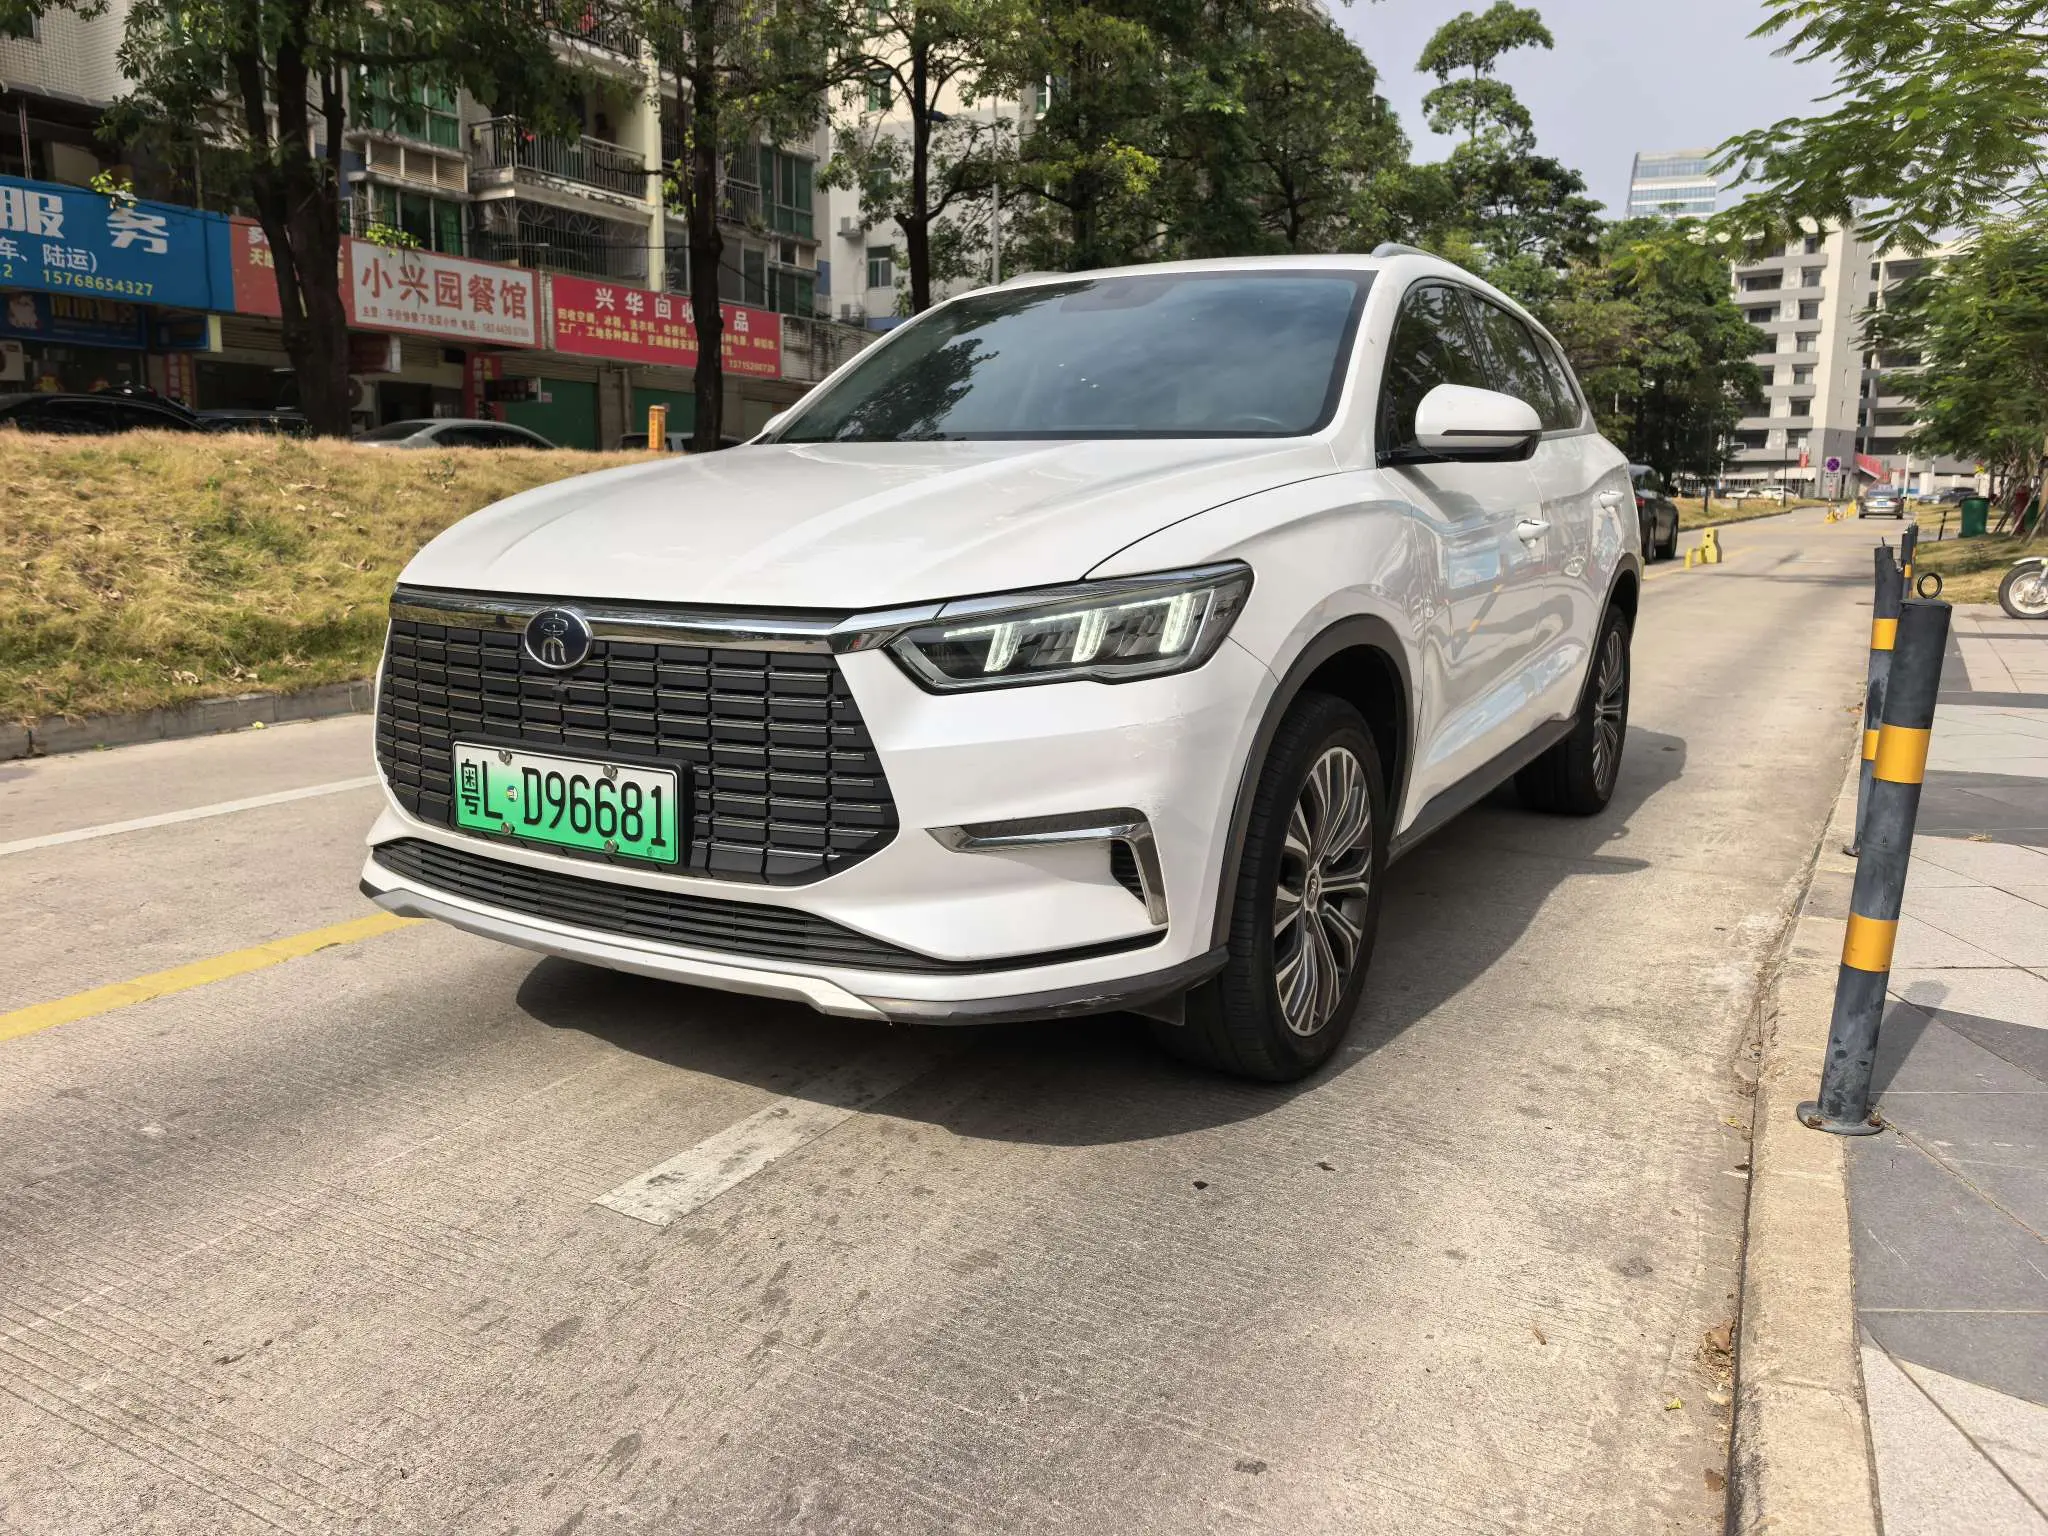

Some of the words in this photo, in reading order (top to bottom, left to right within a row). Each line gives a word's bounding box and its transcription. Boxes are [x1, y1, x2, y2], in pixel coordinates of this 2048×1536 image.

[43, 269, 153, 296] 15768654327
[362, 258, 527, 321] 小兴园餐馆
